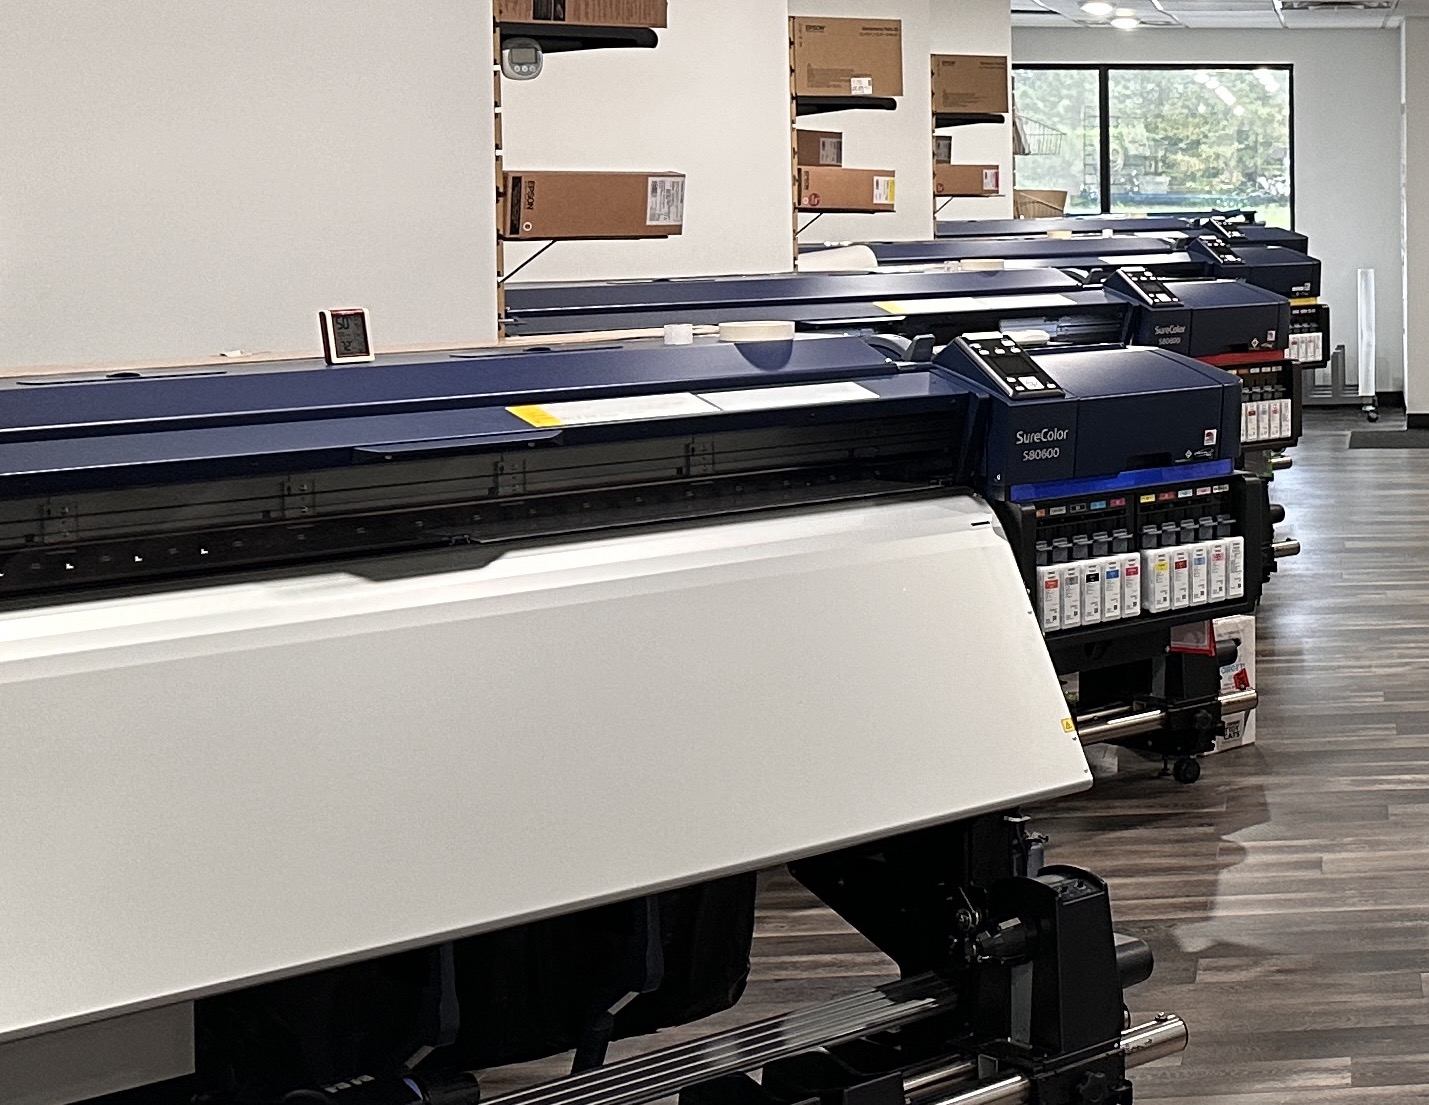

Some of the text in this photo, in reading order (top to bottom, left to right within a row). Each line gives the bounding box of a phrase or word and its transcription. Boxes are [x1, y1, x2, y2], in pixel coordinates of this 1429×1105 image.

[526, 180, 536, 210] EPSON
[1154, 324, 1187, 336] SureColor
[1015, 427, 1069, 445] SureColor
[1022, 447, 1060, 462] S80600
